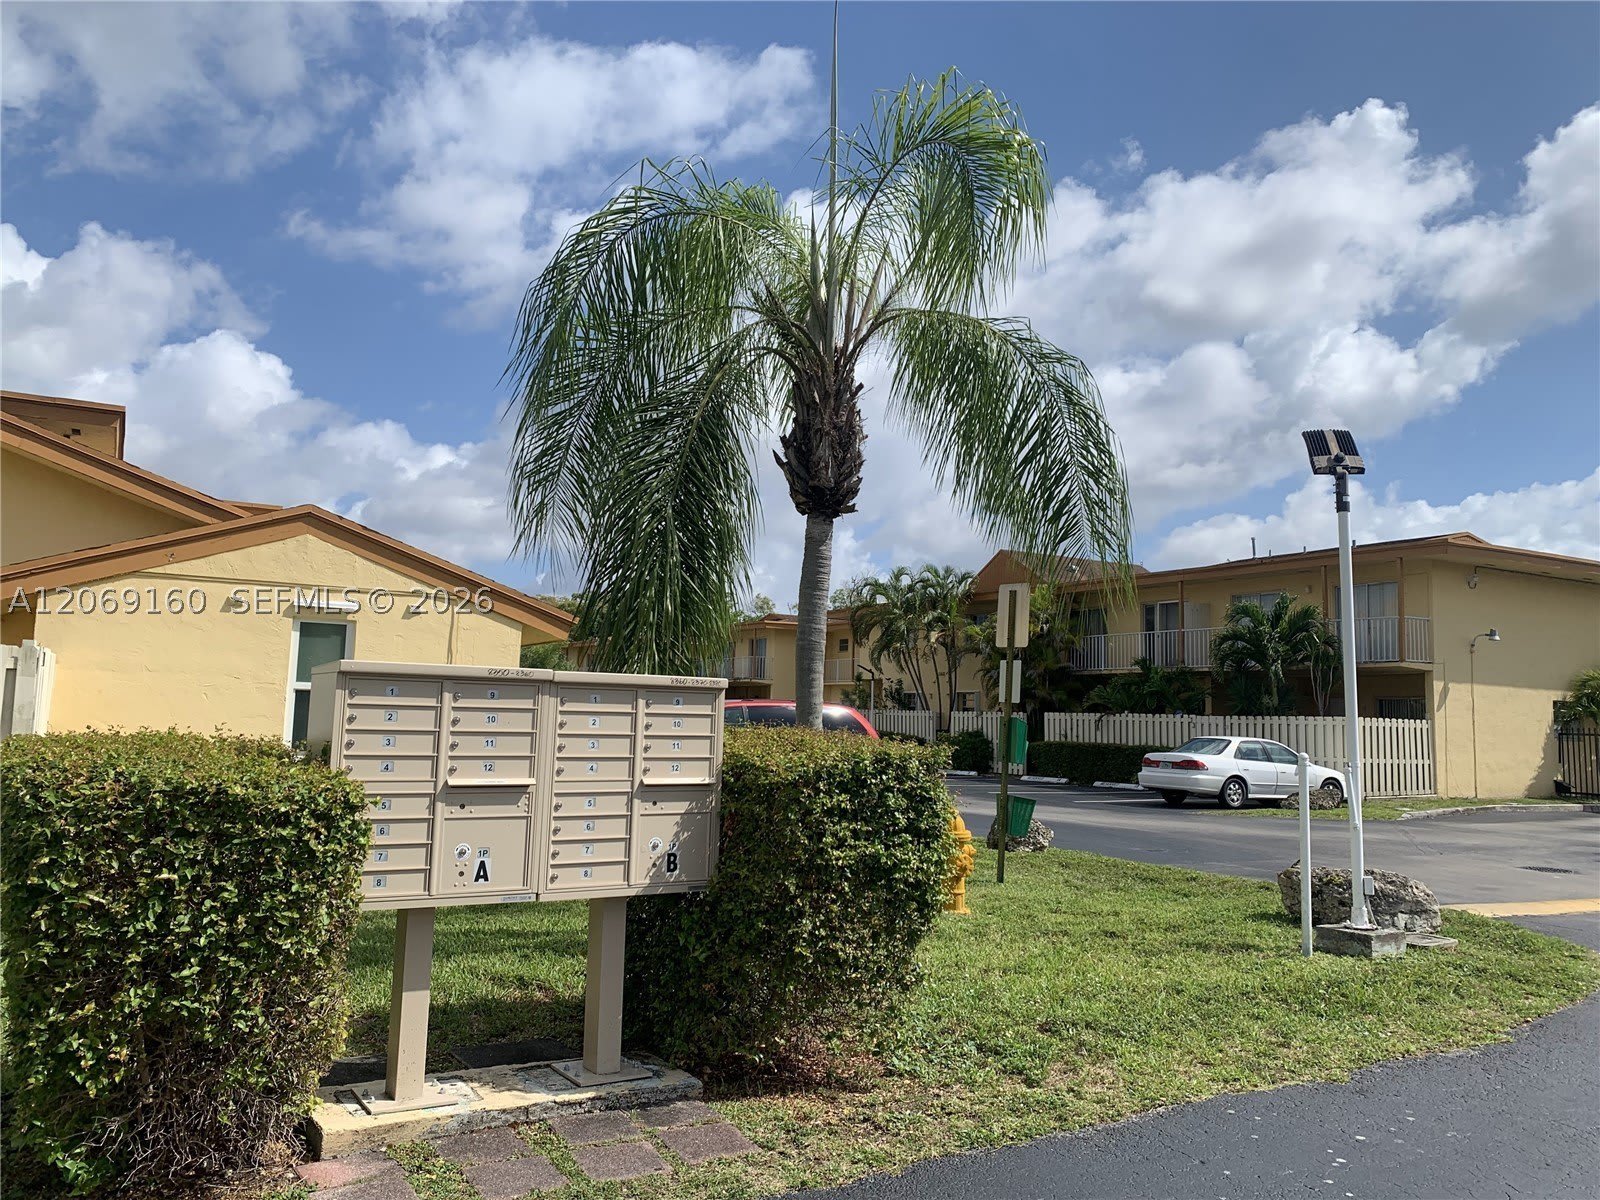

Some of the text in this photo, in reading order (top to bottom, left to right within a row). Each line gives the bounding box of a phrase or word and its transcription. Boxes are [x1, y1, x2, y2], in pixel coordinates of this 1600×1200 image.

[490, 691, 495, 699] 9
[387, 713, 393, 721] 2
[385, 738, 391, 746] 3
[381, 801, 387, 810] 5
[587, 799, 592, 807] 5
[379, 827, 385, 835] 6
[586, 823, 591, 831] 6
[478, 849, 488, 857] 1P
[585, 846, 590, 854] 7
[377, 853, 383, 861] 7
[666, 852, 678, 873] B
[473, 860, 489, 882] A
[583, 870, 589, 878] 8
[376, 879, 382, 887] 8
